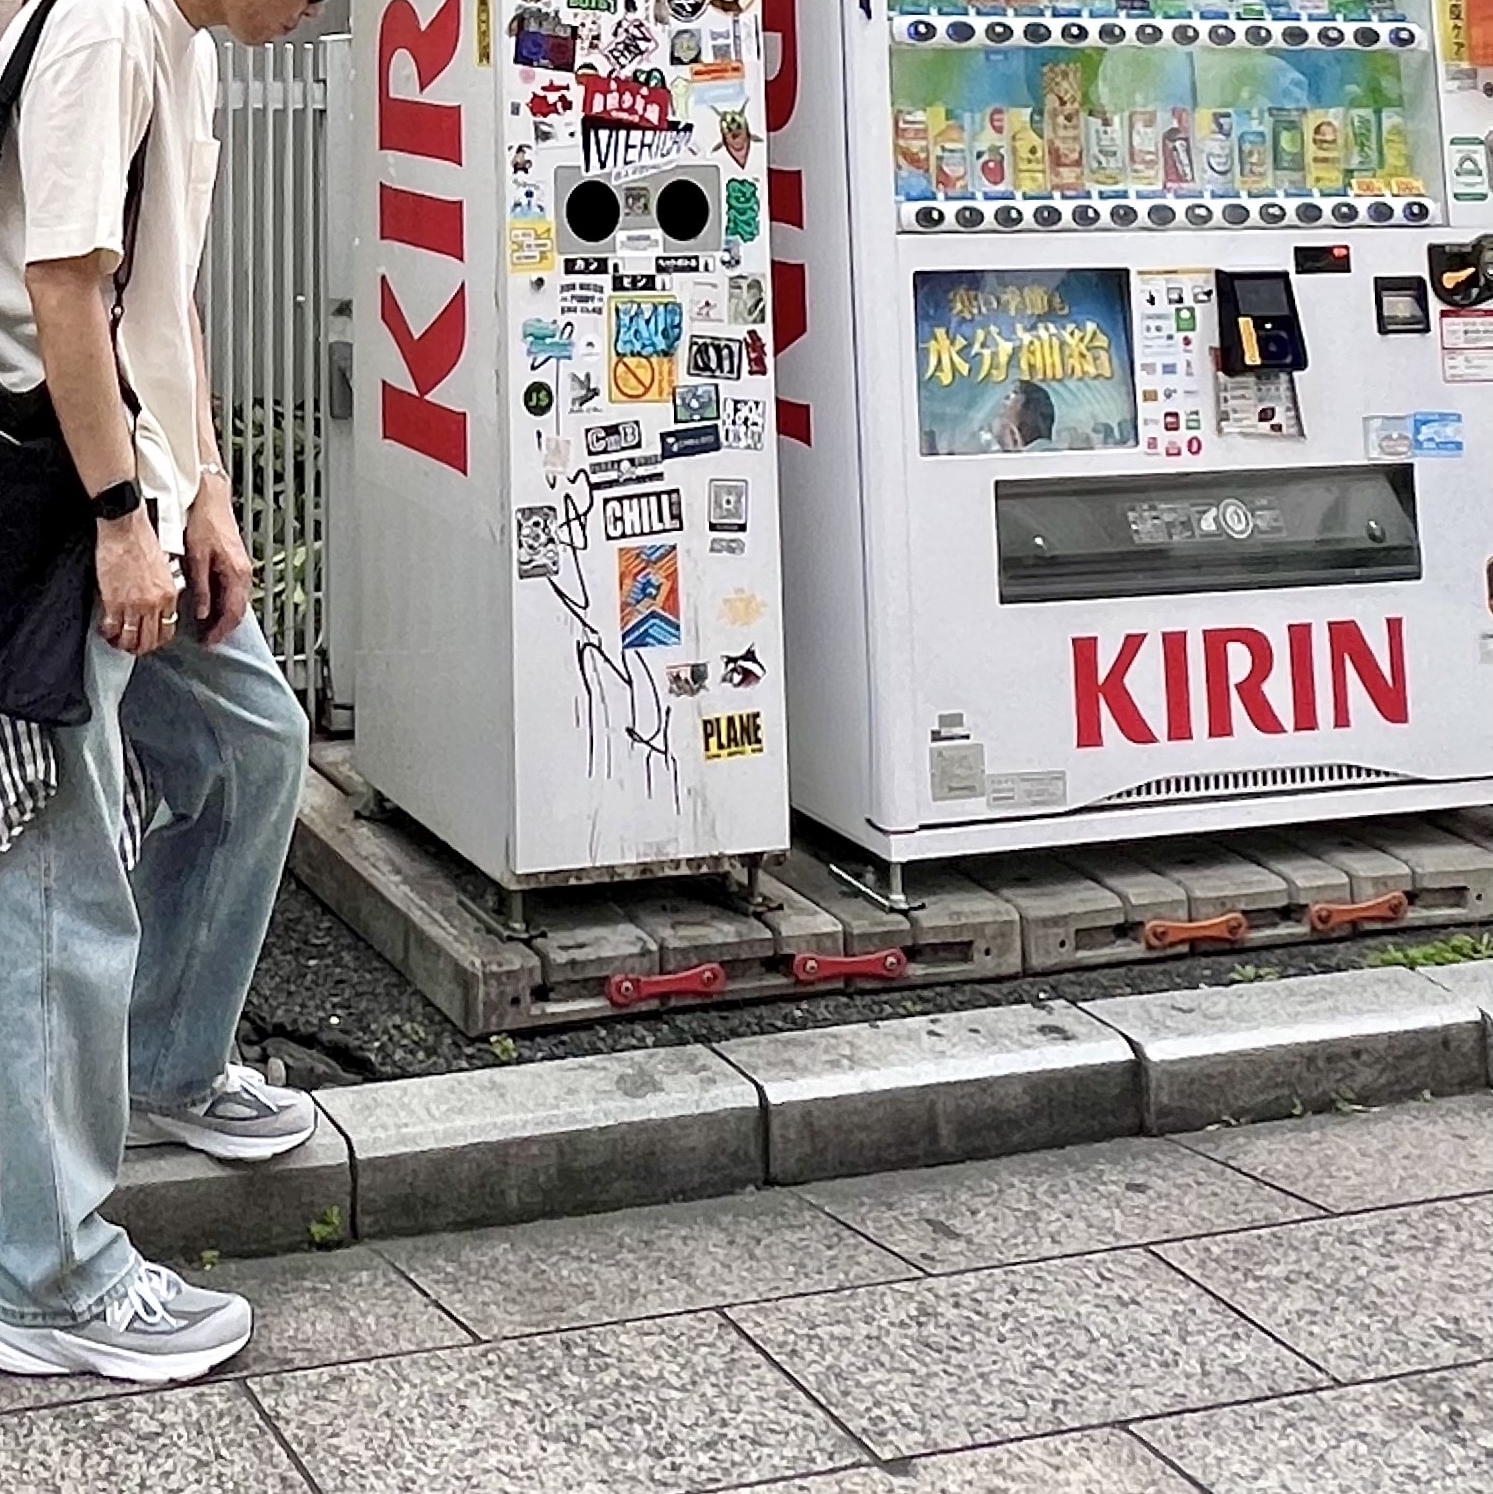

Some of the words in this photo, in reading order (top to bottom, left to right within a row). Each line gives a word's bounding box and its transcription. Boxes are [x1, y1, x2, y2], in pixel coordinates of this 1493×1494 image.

[919, 320, 1114, 387] 水分補給
[606, 493, 674, 539] CHILL
[1071, 616, 1409, 749] KIRIN
[702, 712, 762, 752] PLANE
